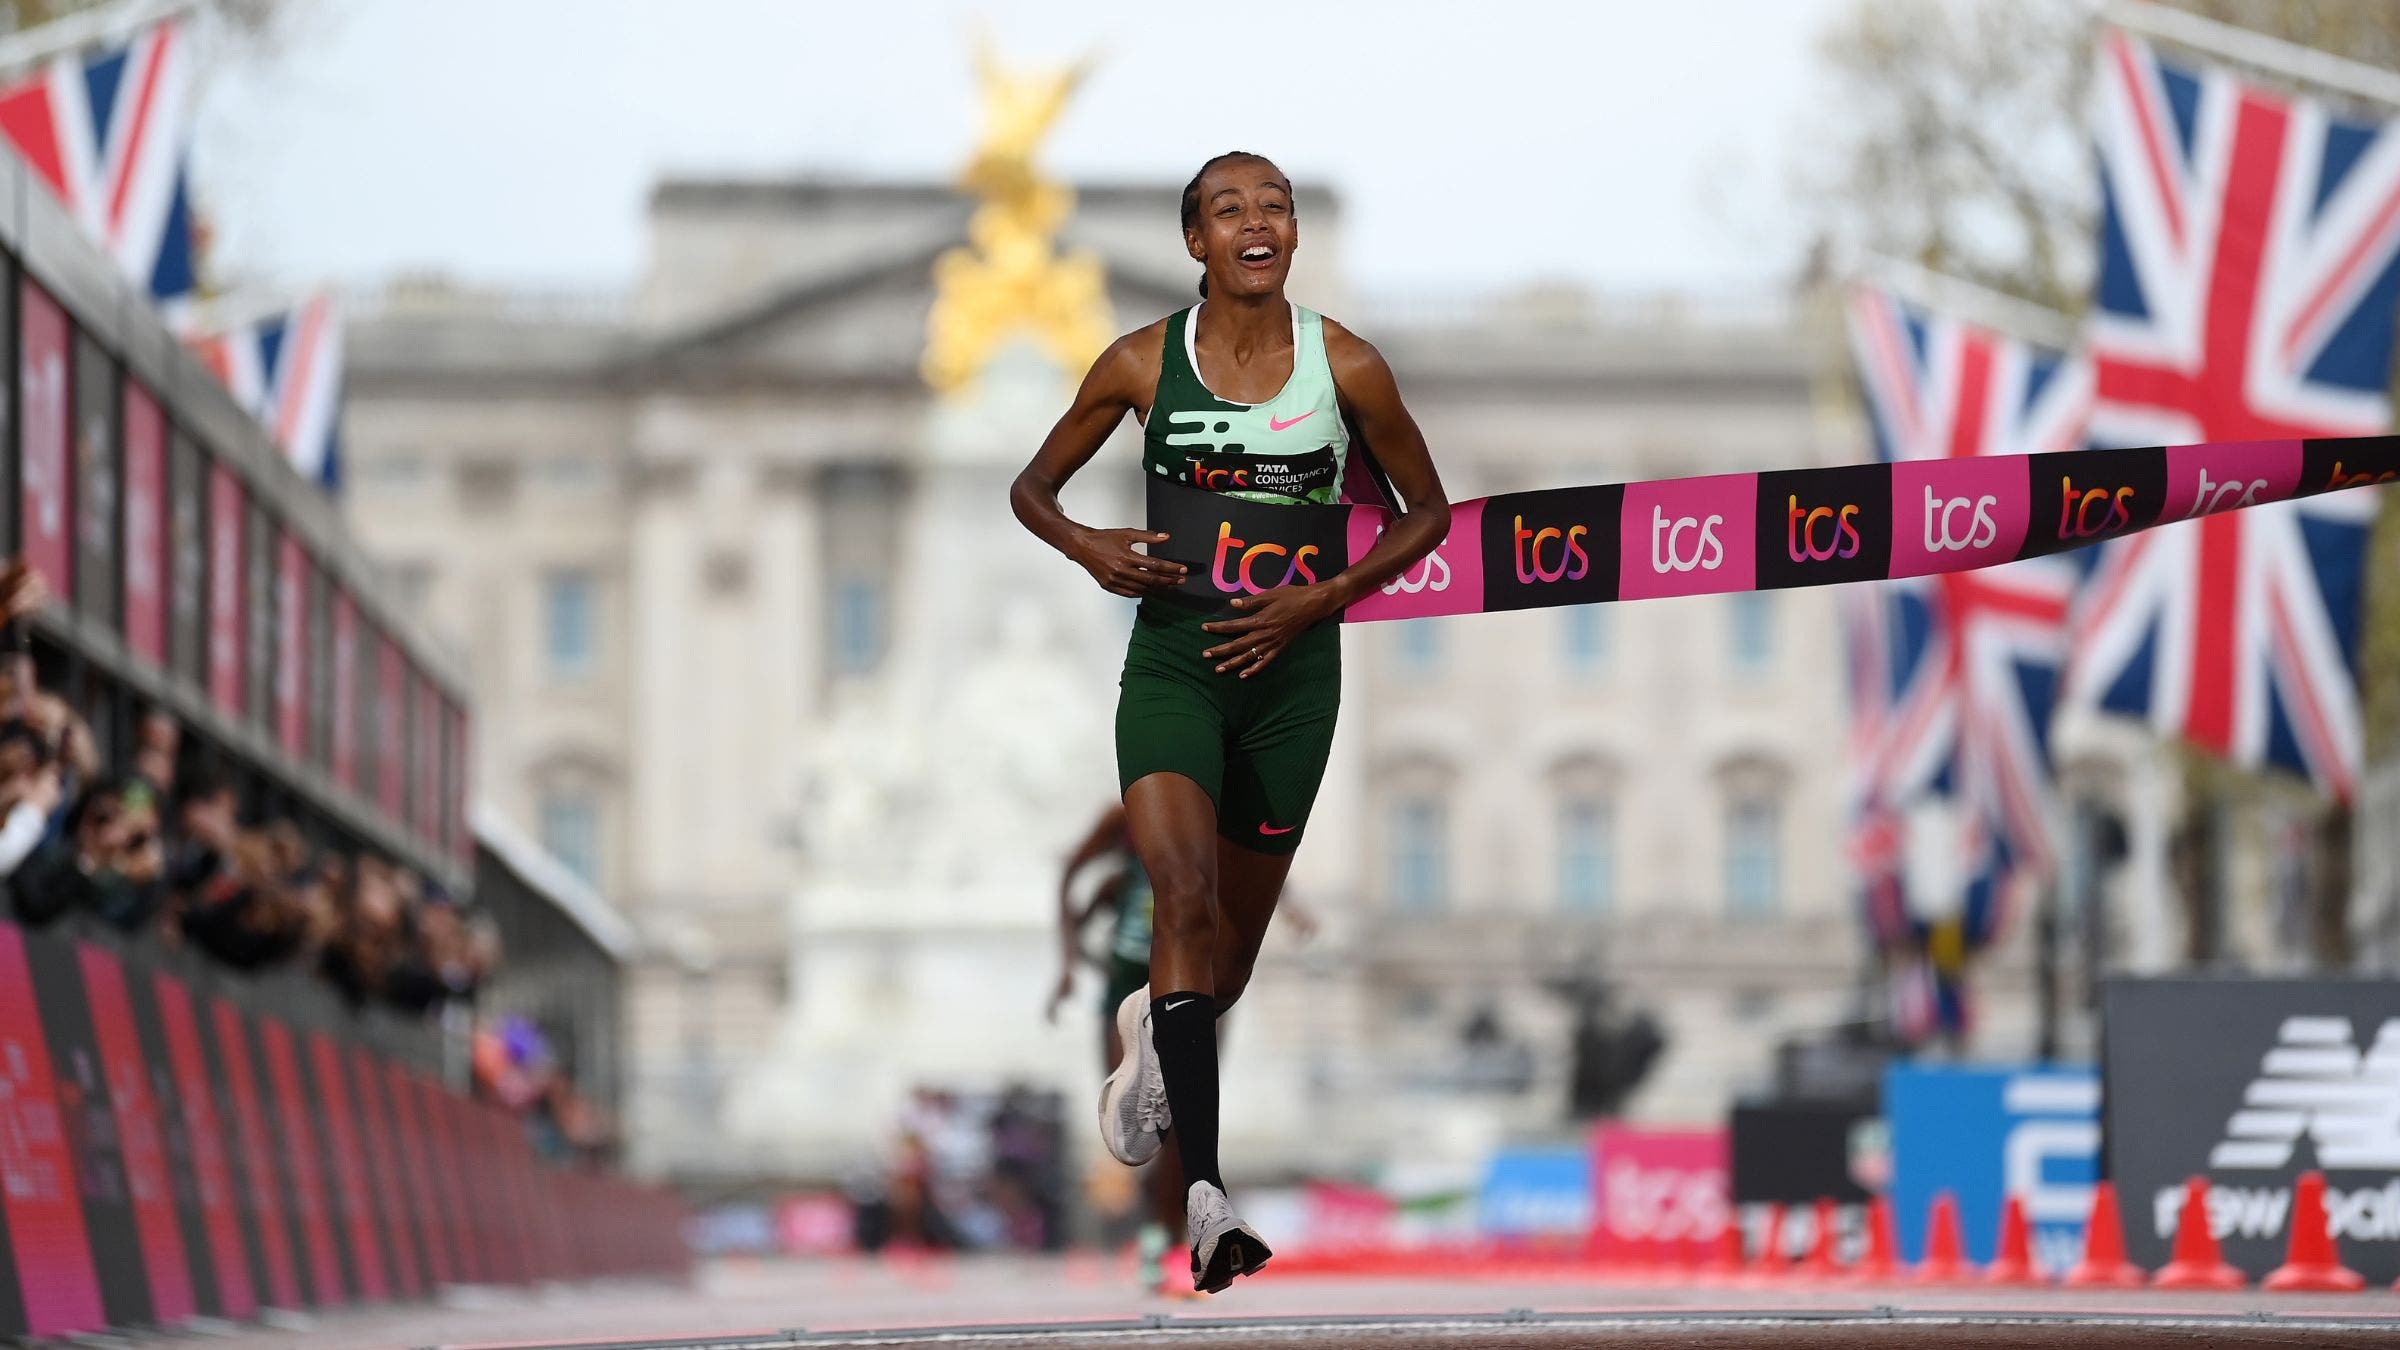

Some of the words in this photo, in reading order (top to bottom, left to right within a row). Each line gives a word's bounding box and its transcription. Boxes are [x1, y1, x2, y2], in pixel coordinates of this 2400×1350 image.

[1195, 461, 1248, 490] tcs
[1255, 464, 1289, 473] TATA
[1255, 467, 1329, 485] CONSULTANCY
[1652, 505, 1724, 574] tcs
[1788, 495, 1860, 563] tcs
[1923, 485, 1997, 553] tcs
[2058, 476, 2135, 540] tcs
[1211, 521, 1319, 596] tcs
[1377, 525, 1451, 595] cs
[1514, 515, 1589, 584] tcs
